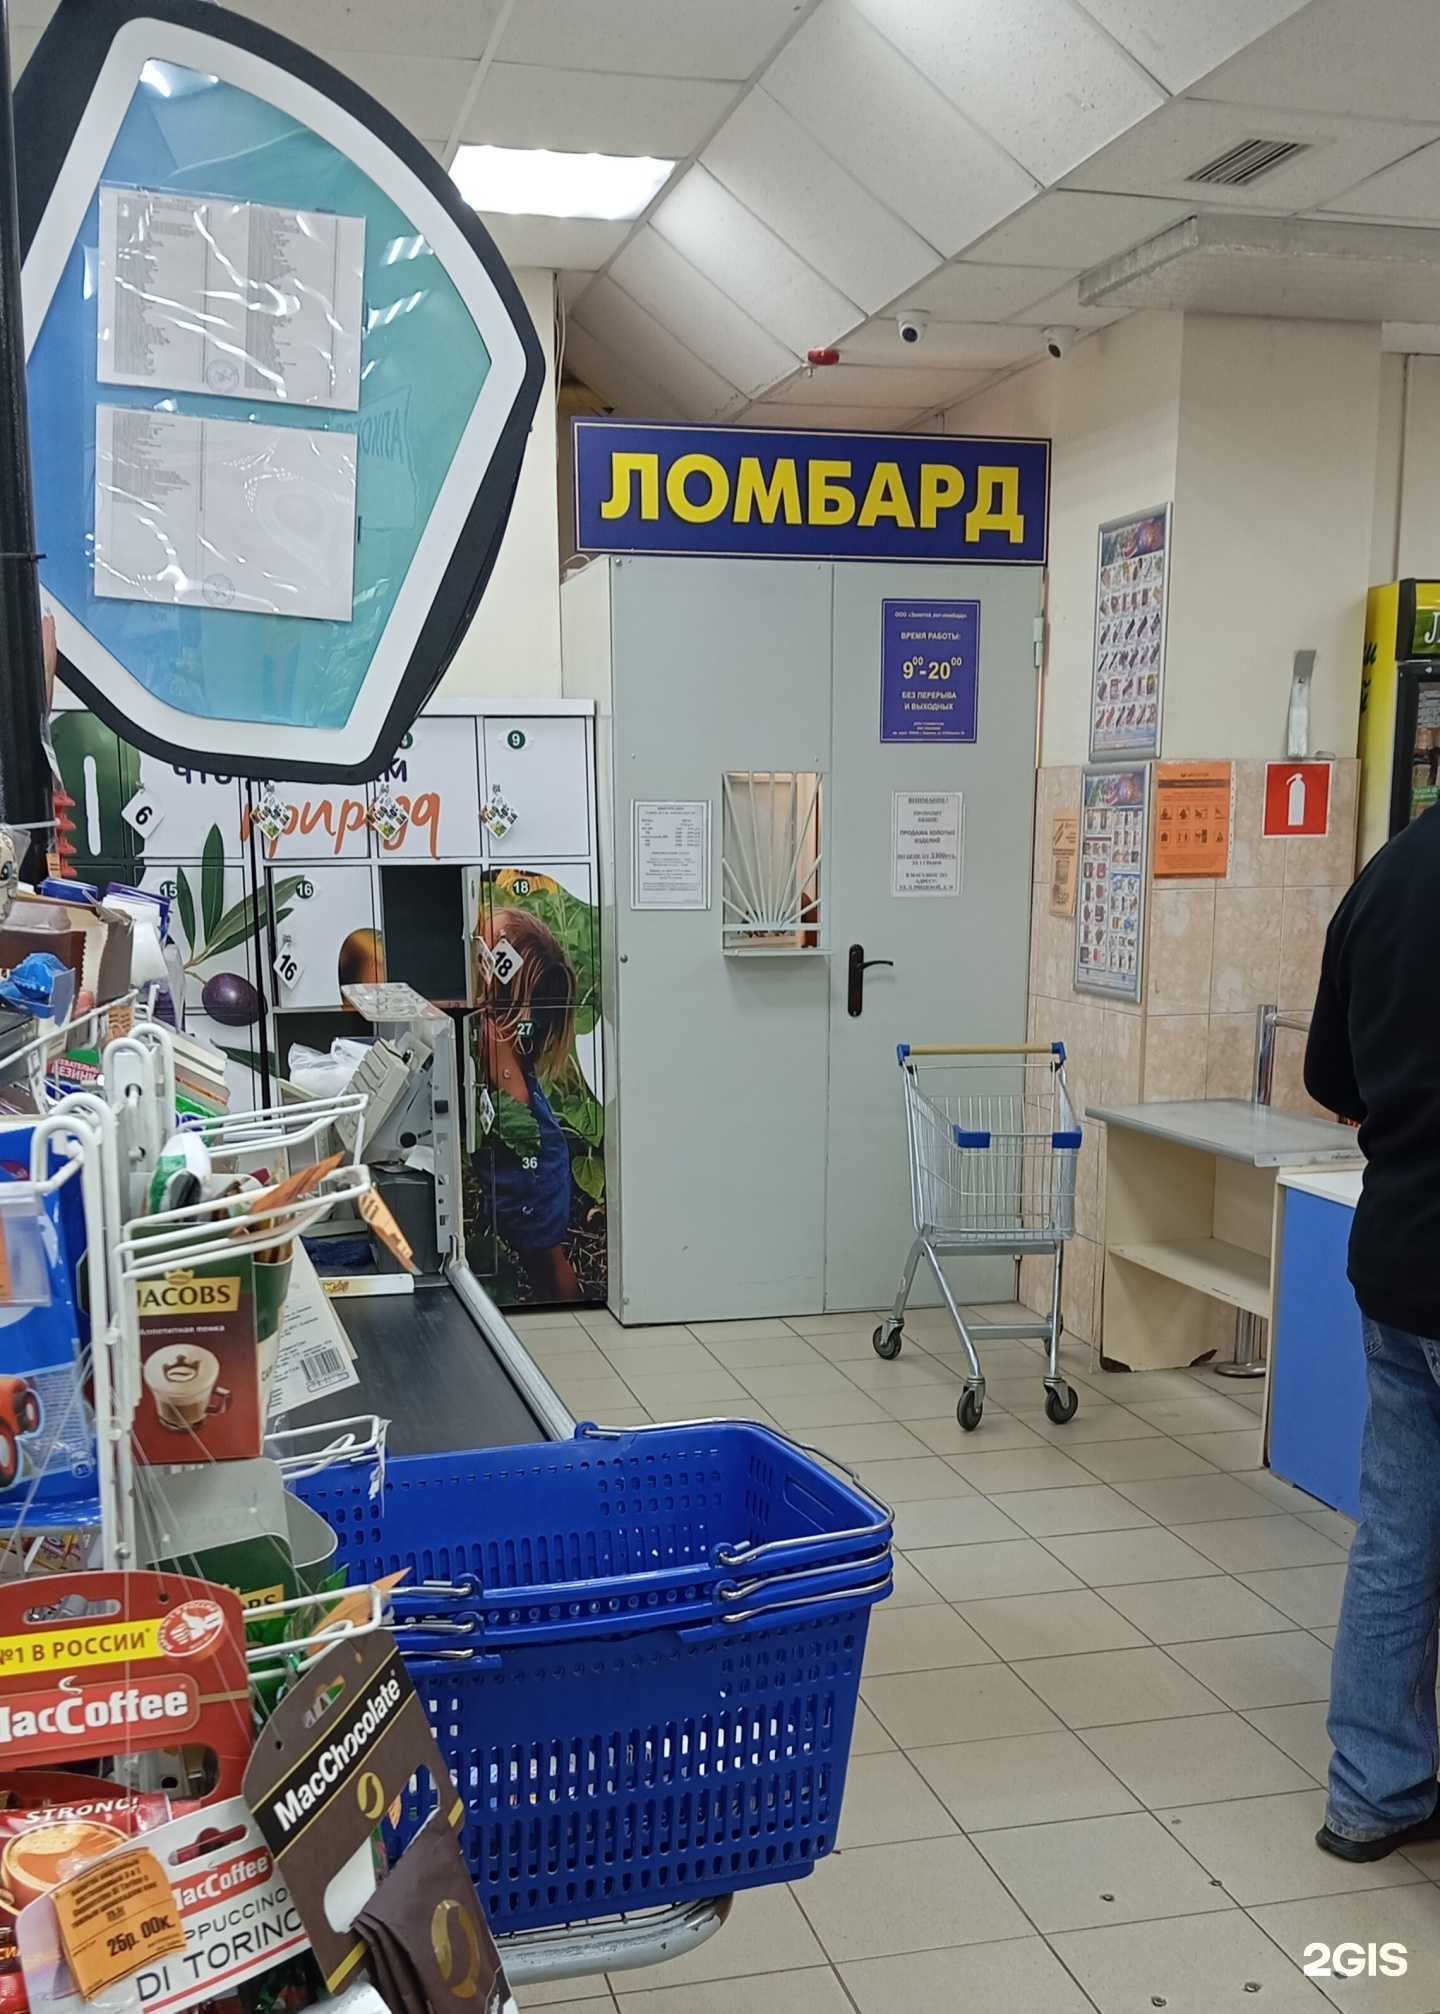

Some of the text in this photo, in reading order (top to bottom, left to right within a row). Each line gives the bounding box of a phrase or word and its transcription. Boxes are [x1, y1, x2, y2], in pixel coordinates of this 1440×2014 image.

[600, 452, 1025, 544] ЛОМБАРД
[901, 631, 926, 640] ВРЕМЯ
[902, 691, 957, 699] БЕЗ ПЕРЕРЫВА
[904, 703, 953, 712] И ВЫХОДНЫХ
[511, 732, 521, 747] 9
[135, 806, 153, 825] 6
[161, 883, 178, 897] 15
[297, 883, 313, 897] 16
[513, 881, 529, 895] 18
[279, 954, 297, 981] 16
[495, 951, 513, 977] 18
[517, 1022, 533, 1036] 27
[522, 1156, 538, 1169] 36
[137, 1284, 231, 1308] JACOBS
[32, 1644, 45, 1661] В
[273, 1678, 400, 1832] MacChocolate
[184, 1887, 288, 1941] PPUCCINO
[107, 1915, 175, 1957] 25р. 00к.
[136, 1966, 170, 2001] DI
